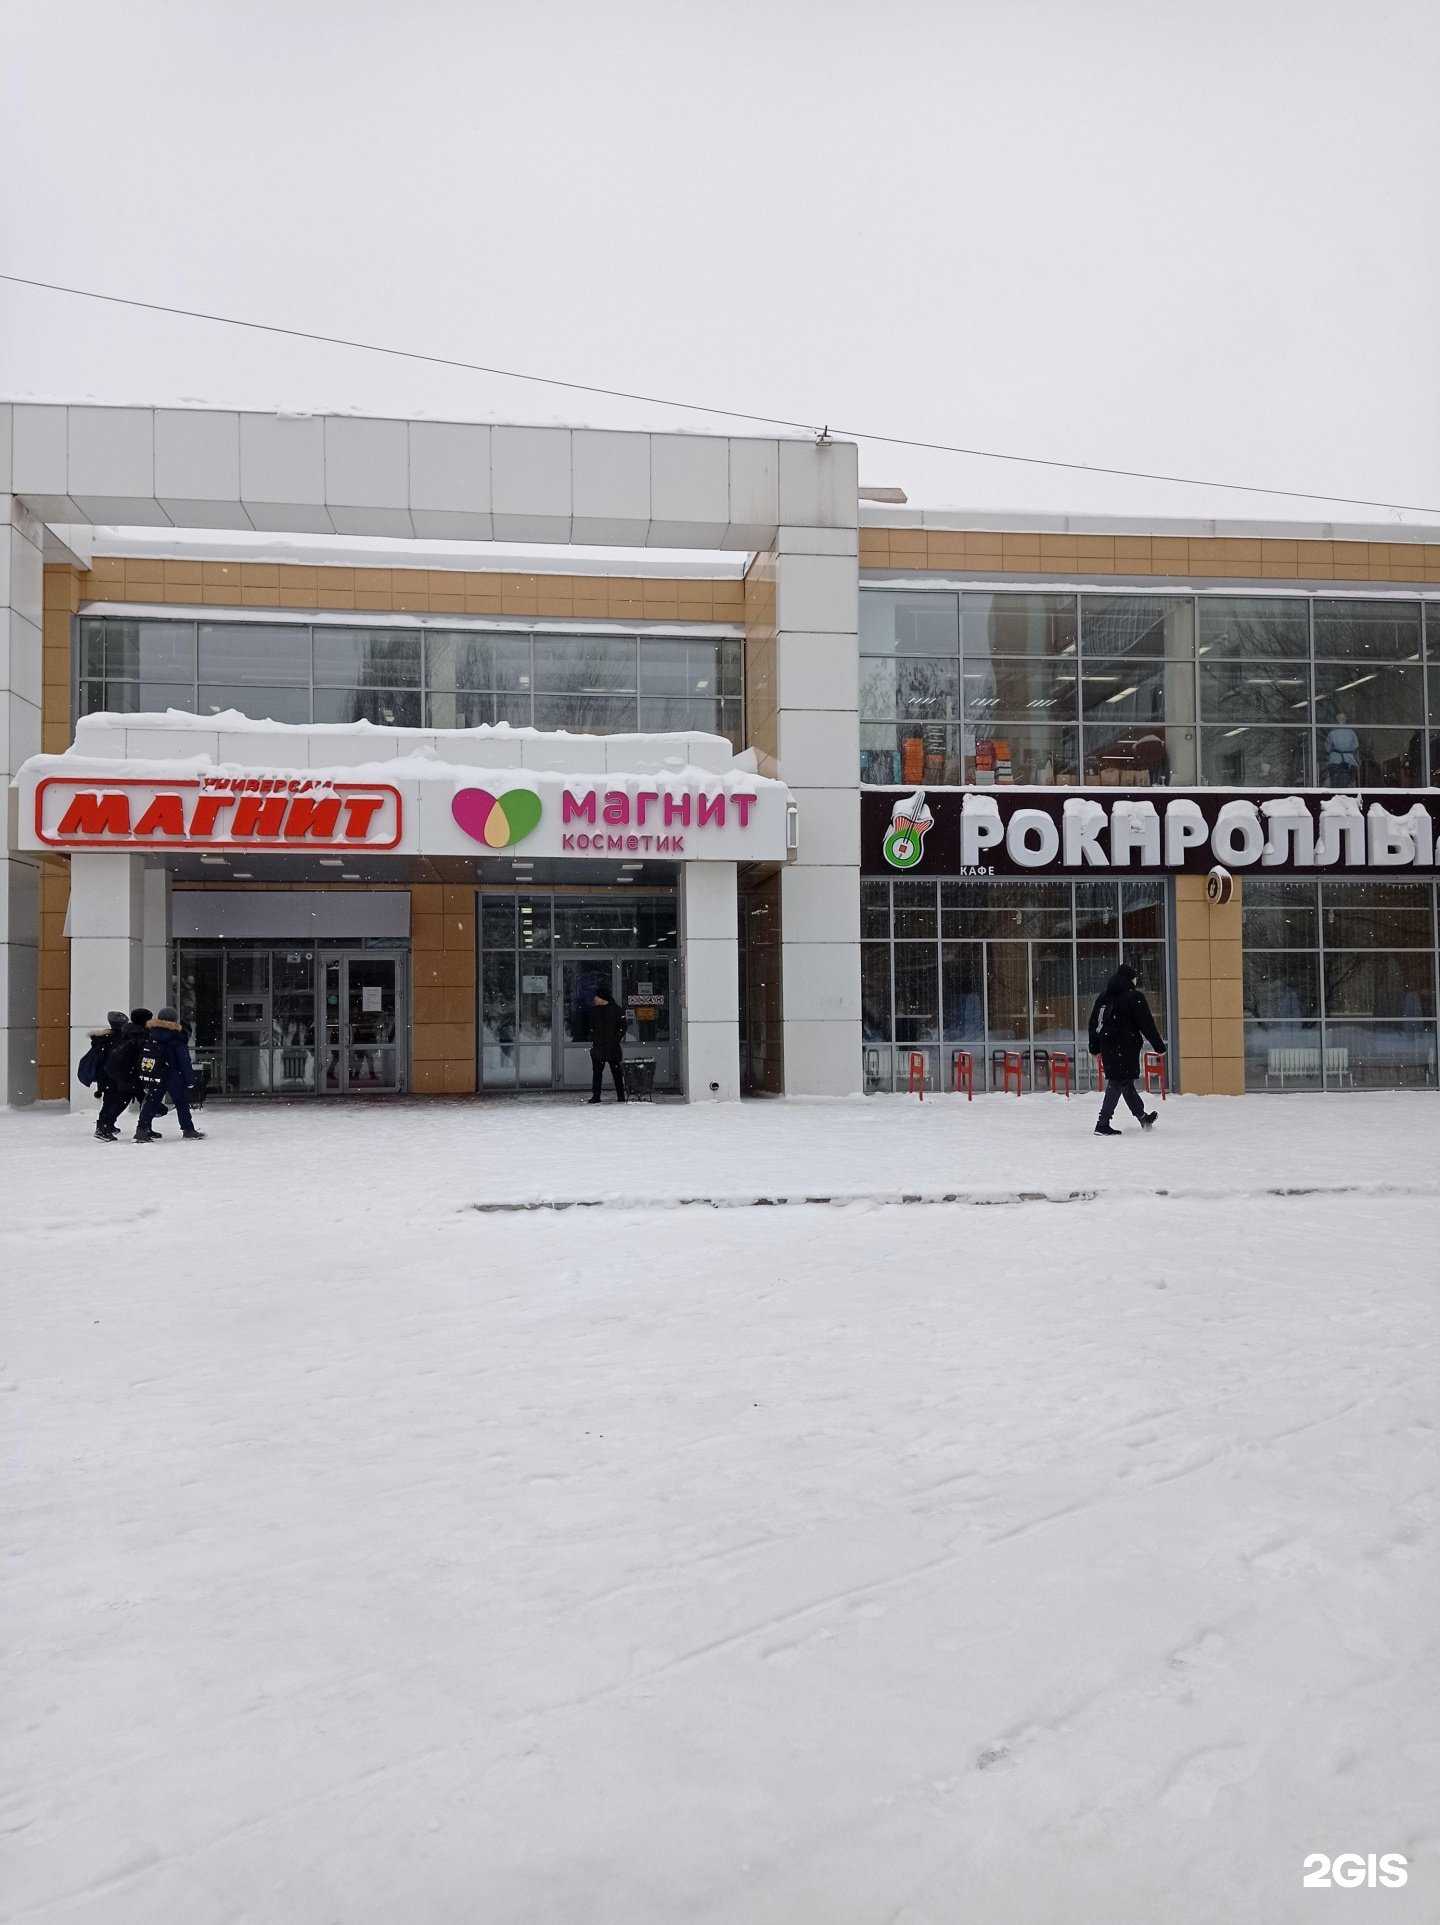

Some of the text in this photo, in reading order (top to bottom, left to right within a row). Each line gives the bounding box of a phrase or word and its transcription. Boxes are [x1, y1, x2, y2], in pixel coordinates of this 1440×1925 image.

[57, 794, 384, 838] МАГНИТ
[960, 804, 1440, 867] РОКНРОЛЛЫ
[960, 865, 995, 876] КАФЕ
